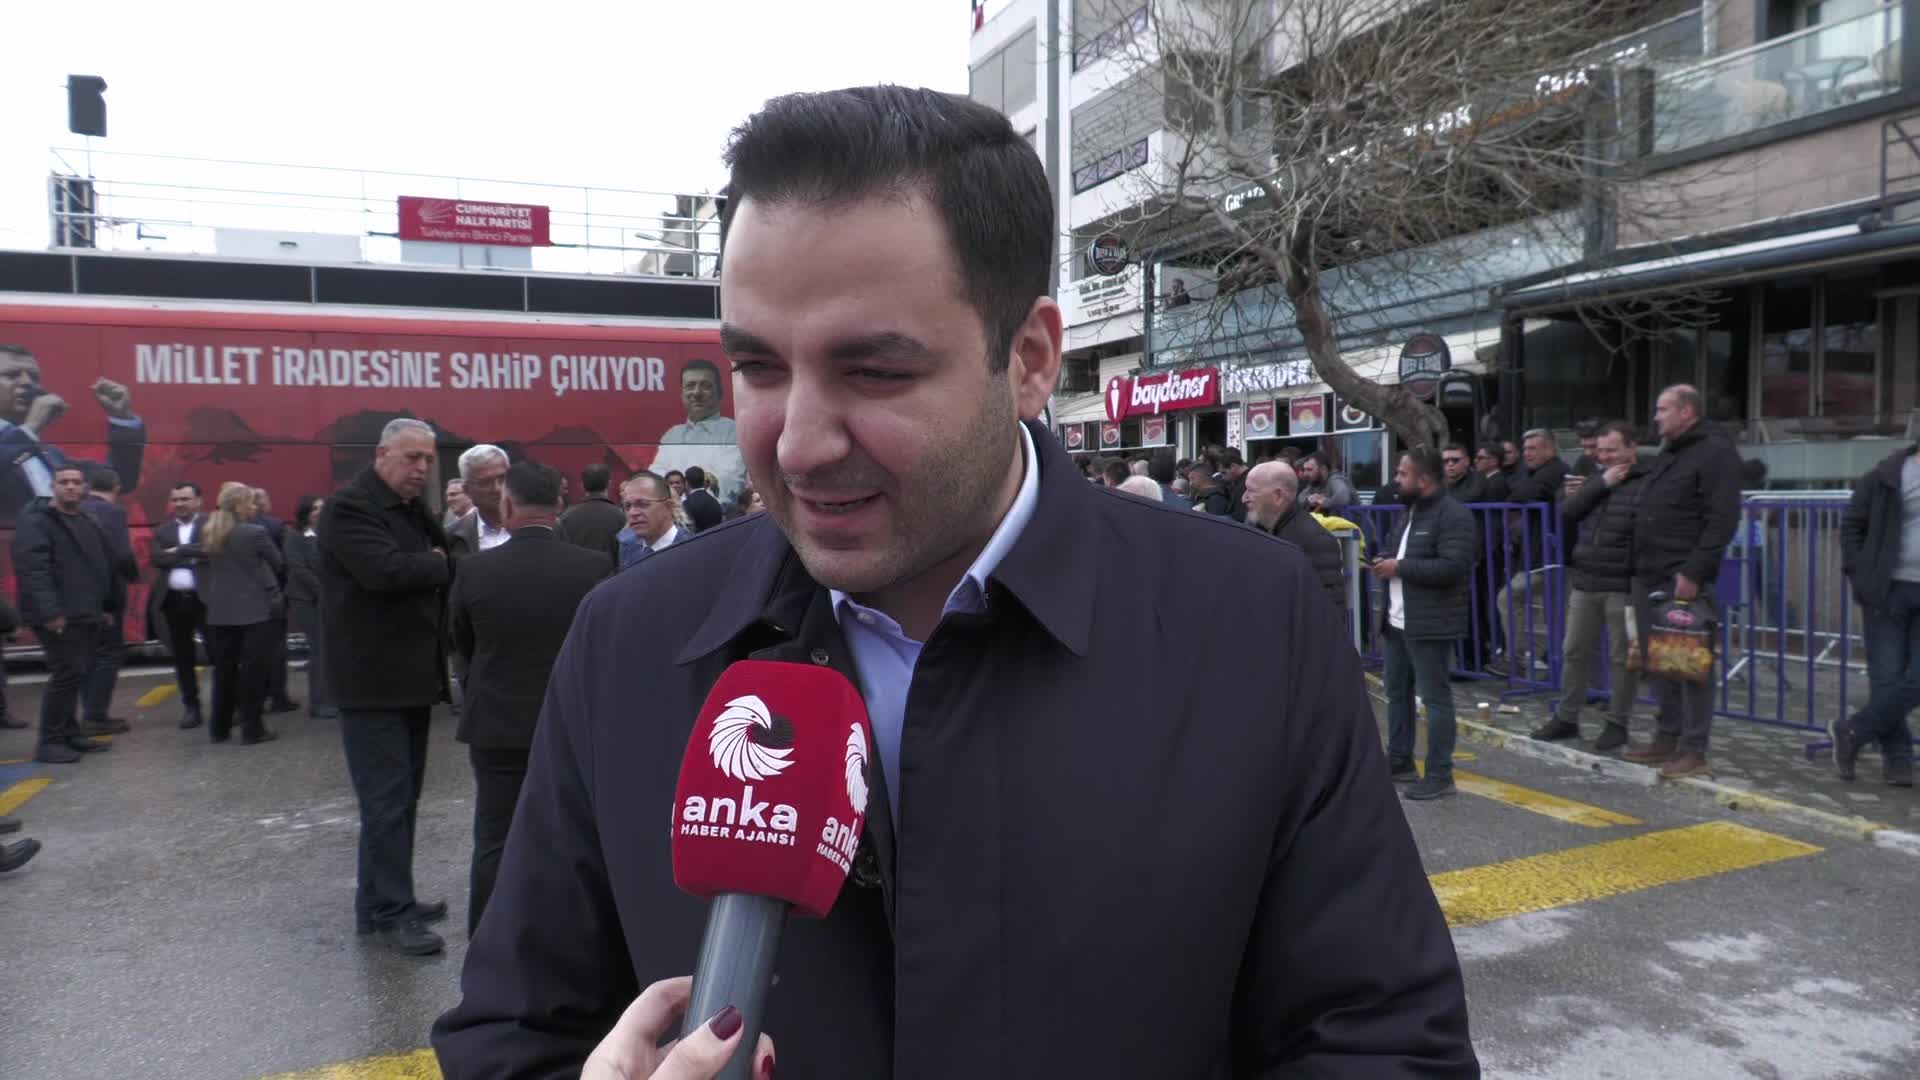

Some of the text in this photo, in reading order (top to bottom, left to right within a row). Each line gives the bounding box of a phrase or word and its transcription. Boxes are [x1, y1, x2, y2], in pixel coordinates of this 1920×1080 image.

[455, 215, 487, 226] HALK
[550, 354, 665, 396] ÇIKIYOR
[1131, 369, 1210, 414] baydöner
[683, 785, 798, 832] anka
[680, 823, 795, 846] HABER AJANSI
